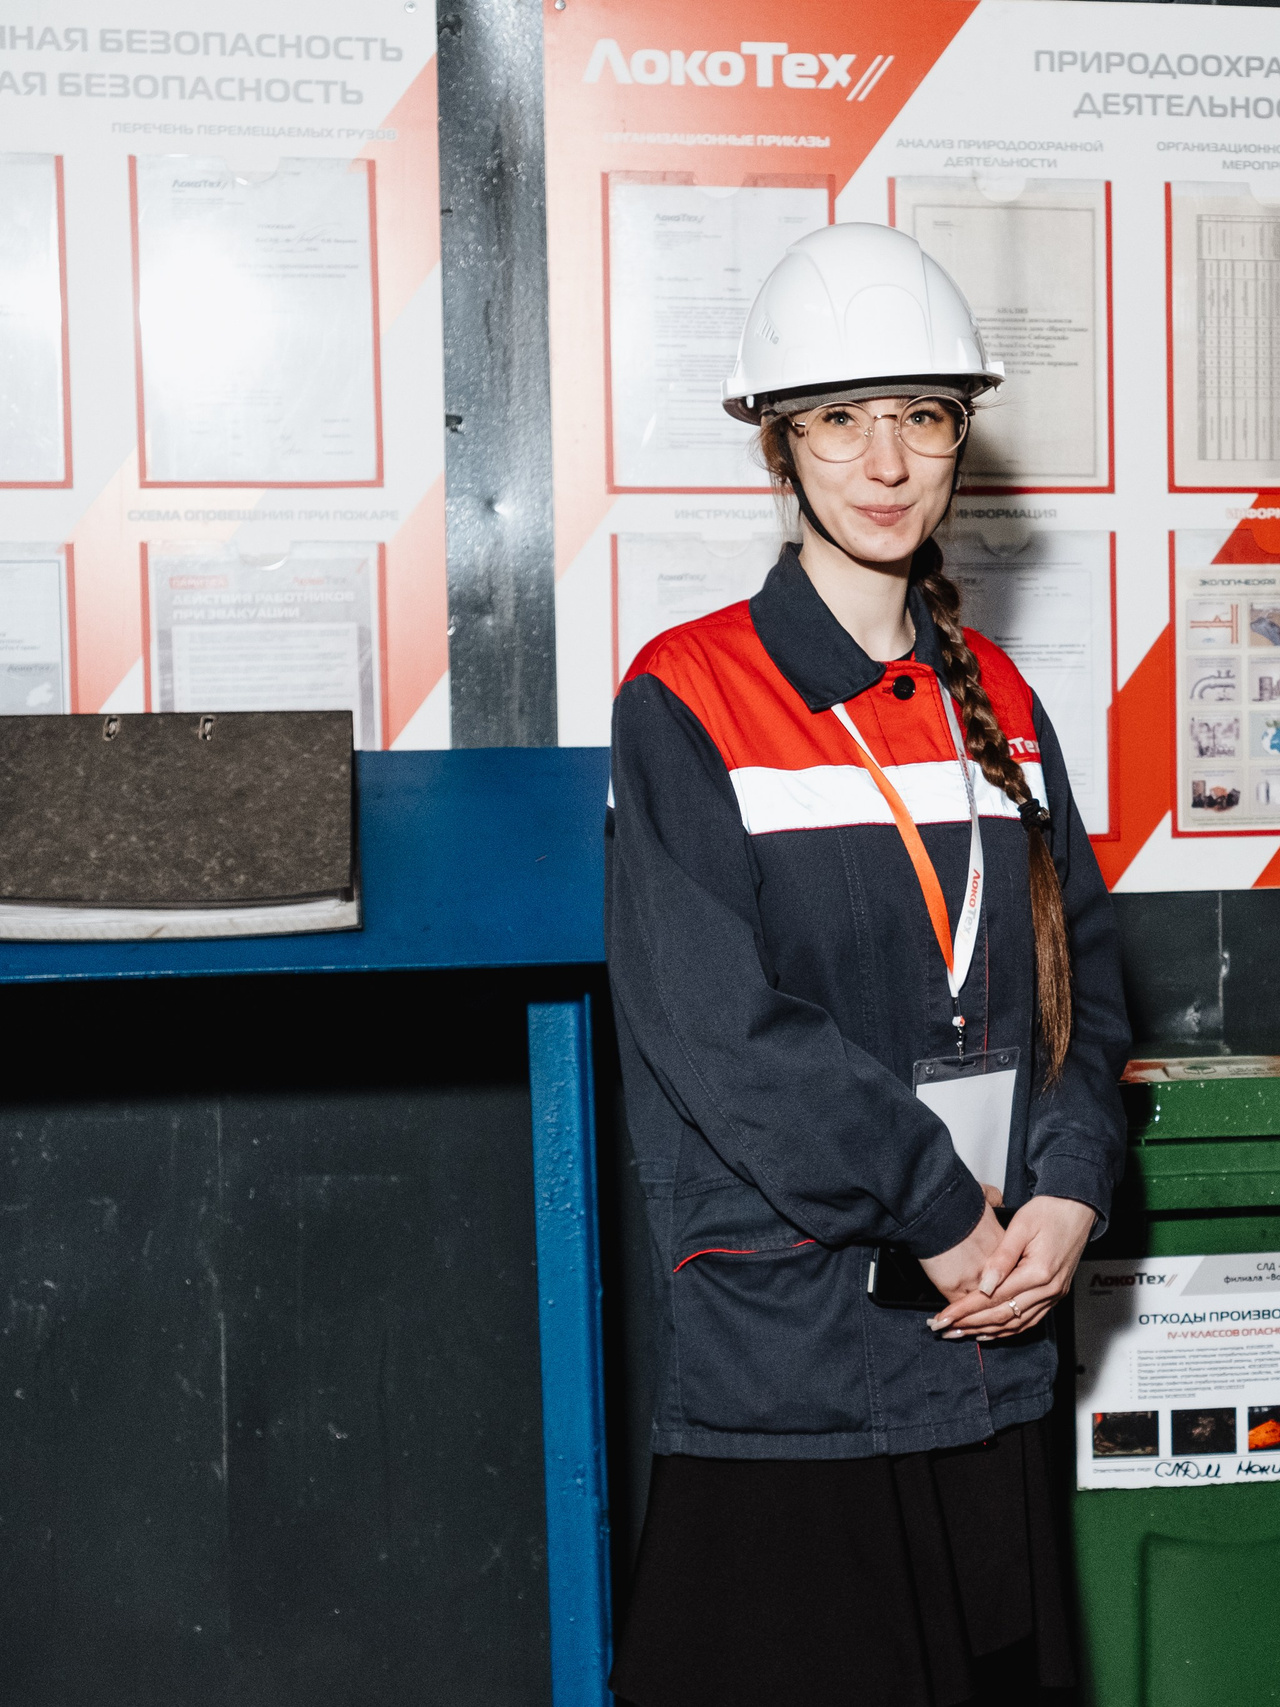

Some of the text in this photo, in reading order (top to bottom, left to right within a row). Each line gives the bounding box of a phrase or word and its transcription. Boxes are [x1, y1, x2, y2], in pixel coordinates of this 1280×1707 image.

[0, 26, 403, 62] НАЯ БЕЗОПАСНОСТЬ
[582, 38, 856, 89] ЛокоТех
[58, 73, 364, 105] БЕЗОПАСНОСТЬ
[111, 122, 397, 141] ПЕРЕЧЕНЬ ПЕРЕМЕЩАЕМЫХ ГРУЗОВ
[756, 133, 830, 148] ПРИКАЗЫ
[896, 138, 1104, 153] АНАЛИЗ ПРИРОДООХРАННОЙ
[944, 156, 1057, 169] ДЕЯТЕЛЬНОСТИ
[127, 509, 399, 525] СХЕМА ОПОВЕЩЕНИЯ ПРИ ПОЖАРЕ
[674, 509, 774, 521] ИНСТРУКЦИИ
[962, 869, 981, 934] ЛокоТех
[1257, 1262, 1275, 1272] СЛД
[1090, 1272, 1166, 1288] ЛокоТех
[1223, 1273, 1263, 1285] филиала
[1138, 1312, 1206, 1326] ОТХОДЫ
[1190, 1329, 1240, 1339] КЛАССОВ
